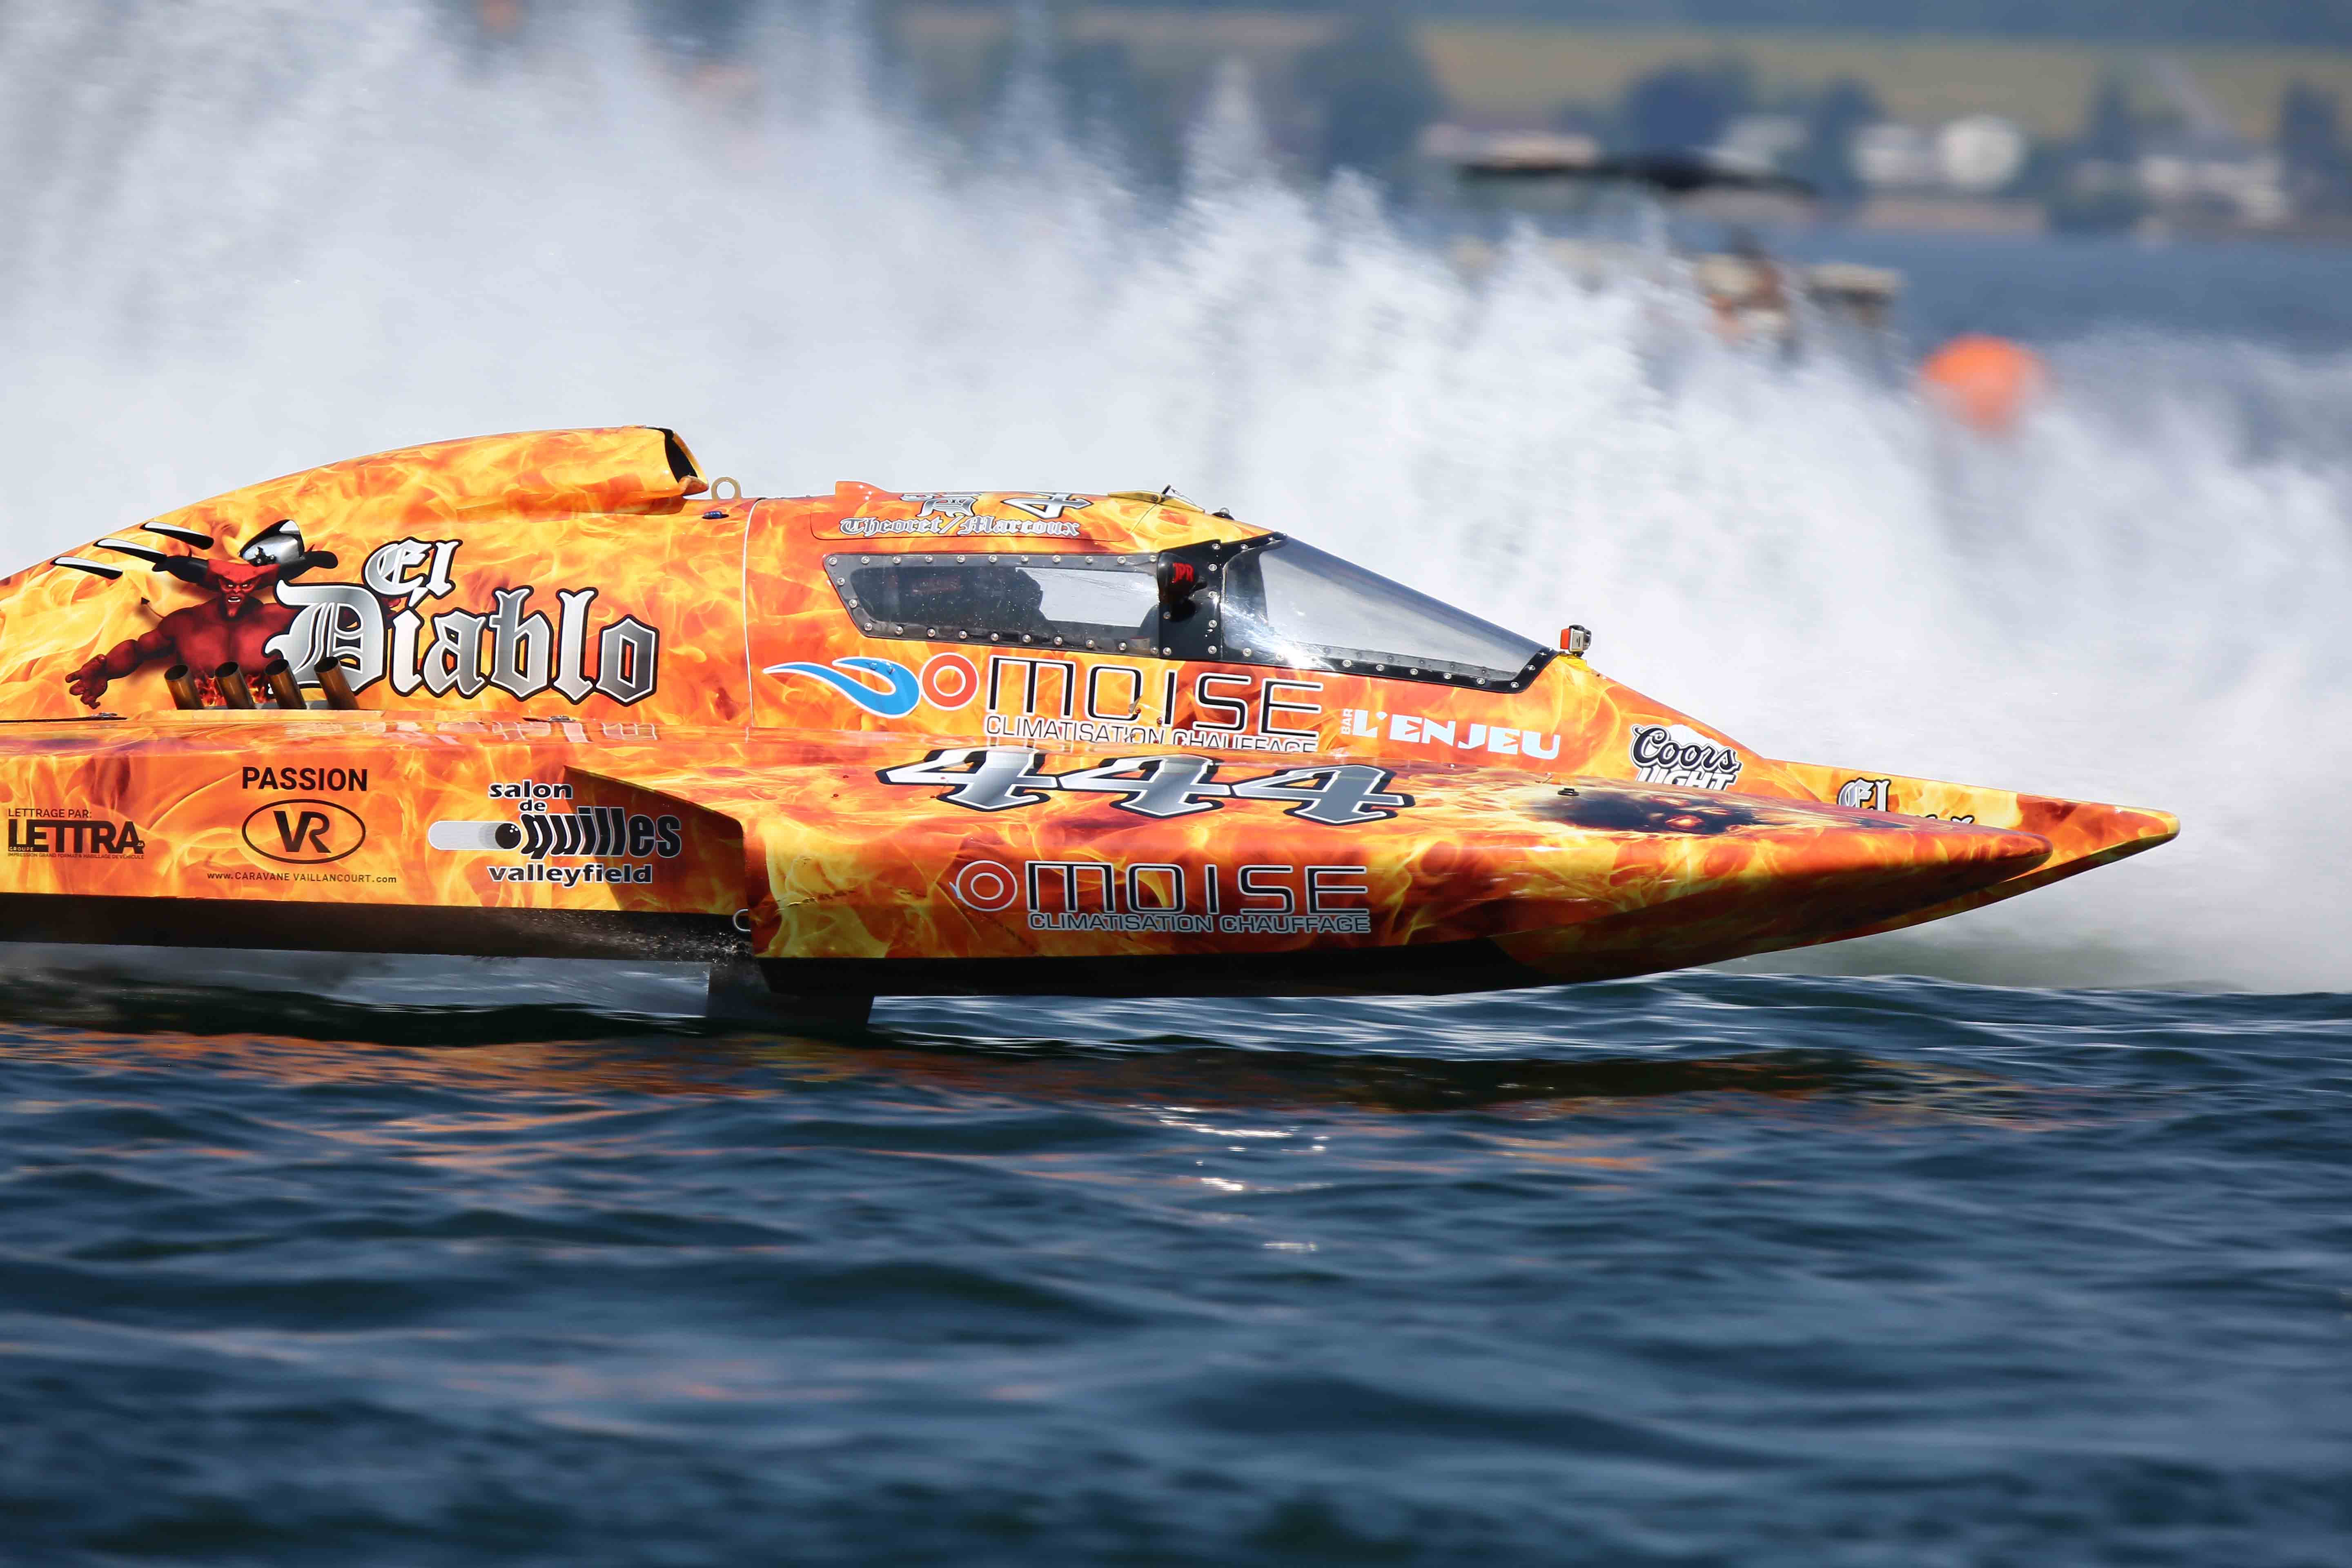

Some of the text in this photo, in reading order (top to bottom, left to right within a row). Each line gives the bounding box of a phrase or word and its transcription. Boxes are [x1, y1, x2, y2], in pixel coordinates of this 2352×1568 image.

[362, 537, 463, 600] El
[263, 579, 659, 707] Diablo
[986, 653, 1323, 739] MOISE
[1341, 708, 1353, 735] BAR
[1352, 709, 1561, 760] L'ENJEU
[1630, 724, 1742, 774] Coors
[242, 766, 368, 791] PASSION
[488, 779, 573, 799] salon
[876, 746, 1415, 826] 444
[8, 808, 92, 818] LETTRAGE PAR:
[519, 799, 546, 812] de
[8, 819, 145, 854] LETTRA
[273, 811, 332, 853] VR
[520, 806, 682, 860] quilles
[487, 863, 653, 888] valleyfield
[1026, 860, 1369, 916] MOISE
[1027, 911, 1371, 933] CLIMATISATION CHAUFFAGE
